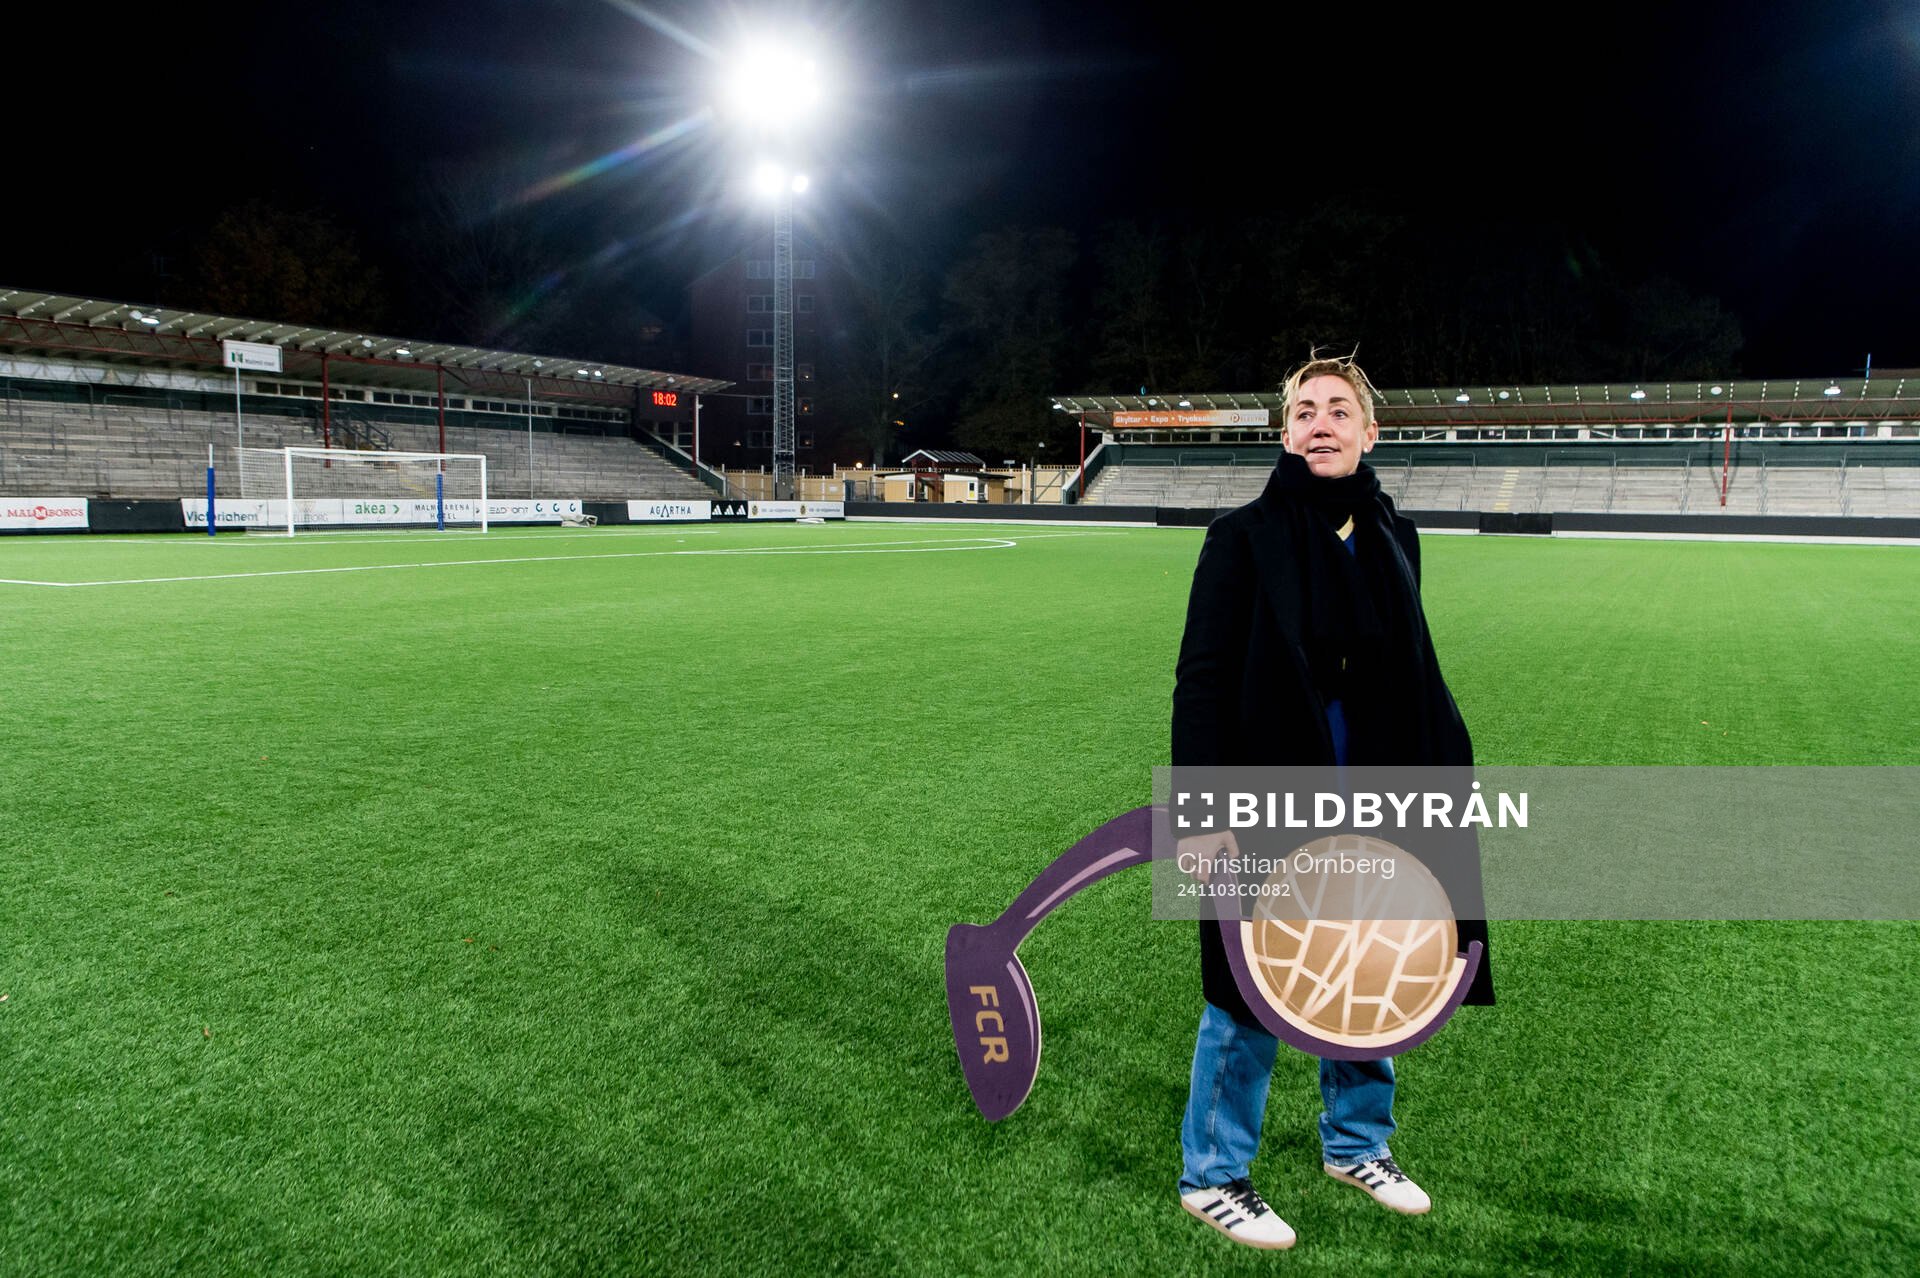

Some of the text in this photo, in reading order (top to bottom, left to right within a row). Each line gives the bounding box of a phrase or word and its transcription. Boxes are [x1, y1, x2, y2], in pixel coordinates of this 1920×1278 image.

[653, 391, 677, 406] 18:02
[1150, 415, 1169, 423] Expo
[8, 506, 84, 520] MALMBORGS
[355, 502, 386, 514] akea
[649, 504, 692, 517] AGARTHA
[969, 985, 1009, 1064] FCR
